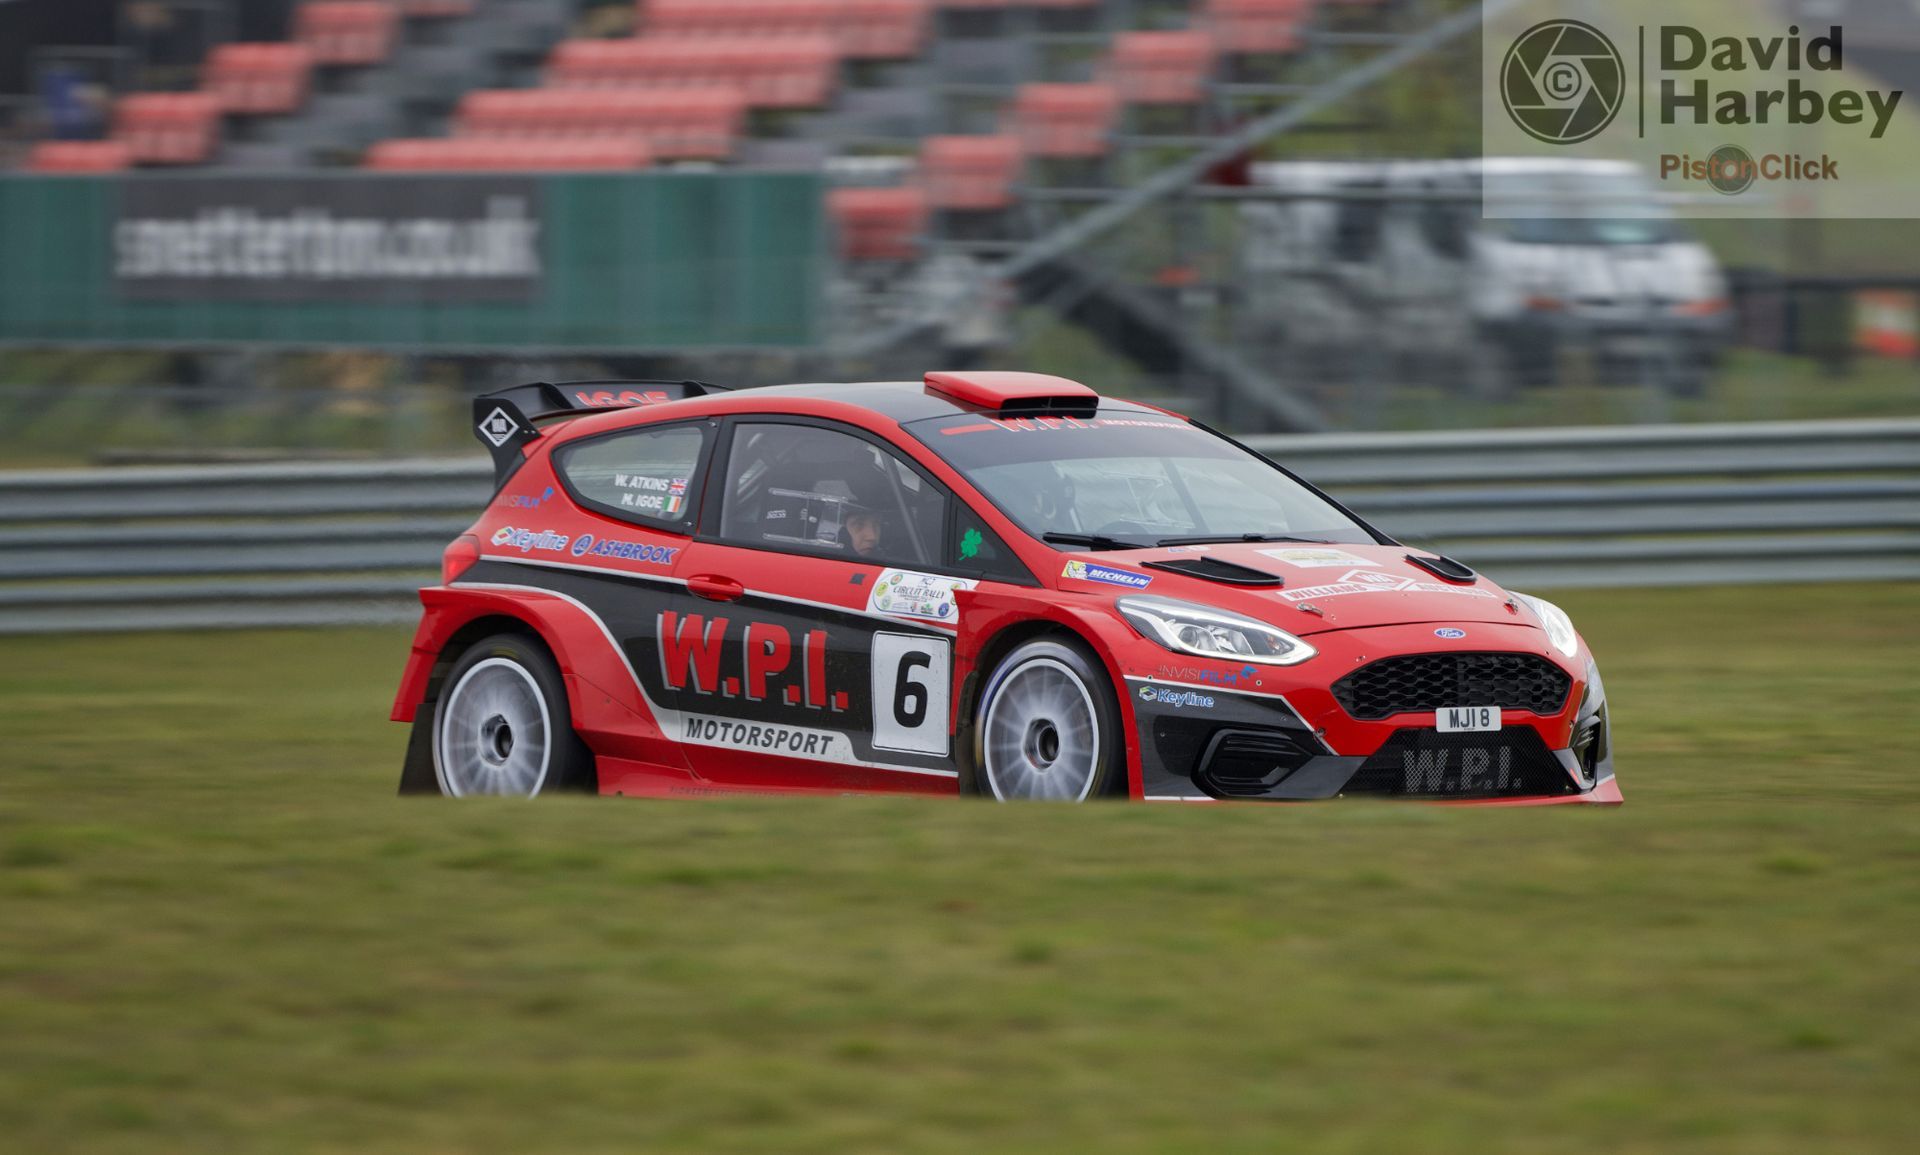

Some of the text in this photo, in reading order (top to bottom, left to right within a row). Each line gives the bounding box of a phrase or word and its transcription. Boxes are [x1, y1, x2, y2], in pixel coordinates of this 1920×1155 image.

[614, 473, 669, 491] W. ATKINS
[635, 494, 665, 508] IGOE
[509, 528, 569, 552] Keyline
[590, 539, 680, 564] ASHBROOK
[1089, 569, 1149, 586] MICHELIN
[1287, 584, 1368, 600] WILLIAMS
[656, 610, 849, 712] W.P.I.
[1159, 666, 1237, 685] INVISIFILM
[892, 650, 932, 728] 6
[1157, 689, 1215, 708] Keyline
[1480, 708, 1490, 727] 8
[685, 717, 834, 756] MOTORSPORT
[1404, 746, 1522, 792] W.P.I.
